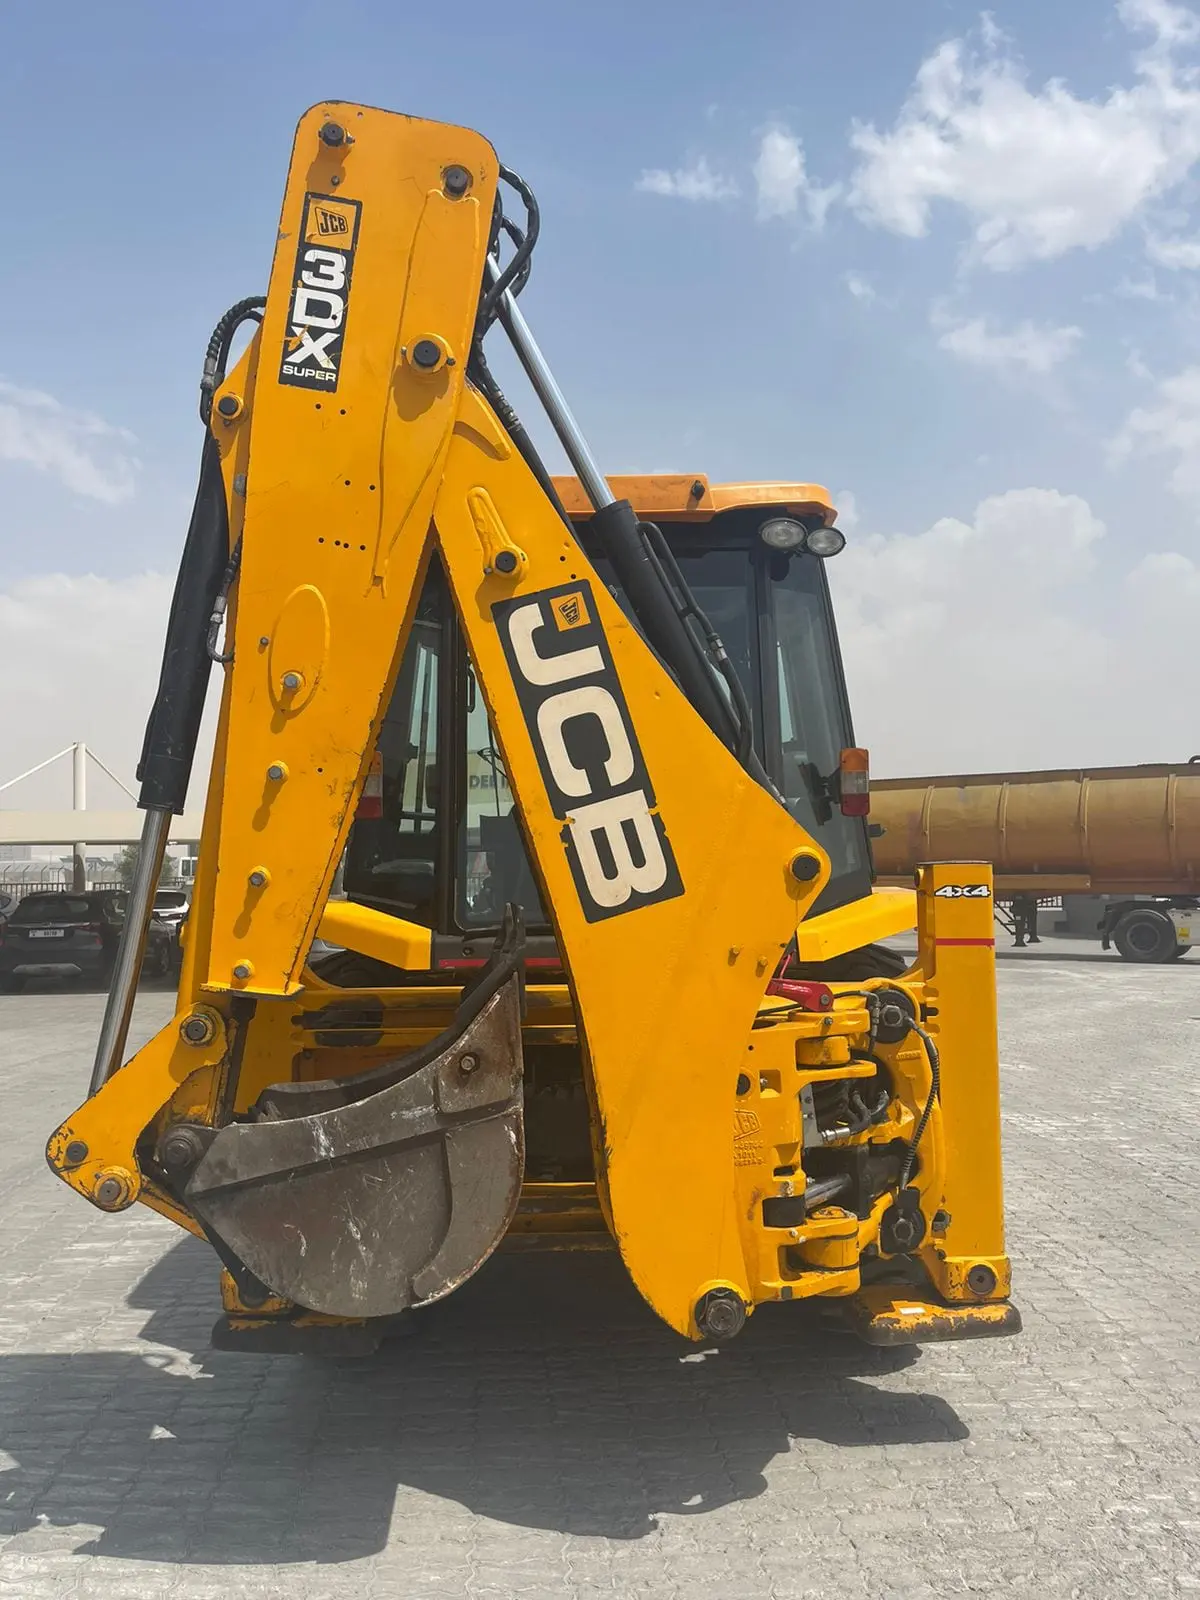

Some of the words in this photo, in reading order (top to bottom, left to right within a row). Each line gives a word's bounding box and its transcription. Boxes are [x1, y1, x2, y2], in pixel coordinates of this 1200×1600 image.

[320, 211, 346, 233] JCB
[285, 249, 347, 370] 3DX
[282, 365, 337, 382] SUPER
[561, 602, 578, 623] JCB
[508, 603, 668, 907] JCB
